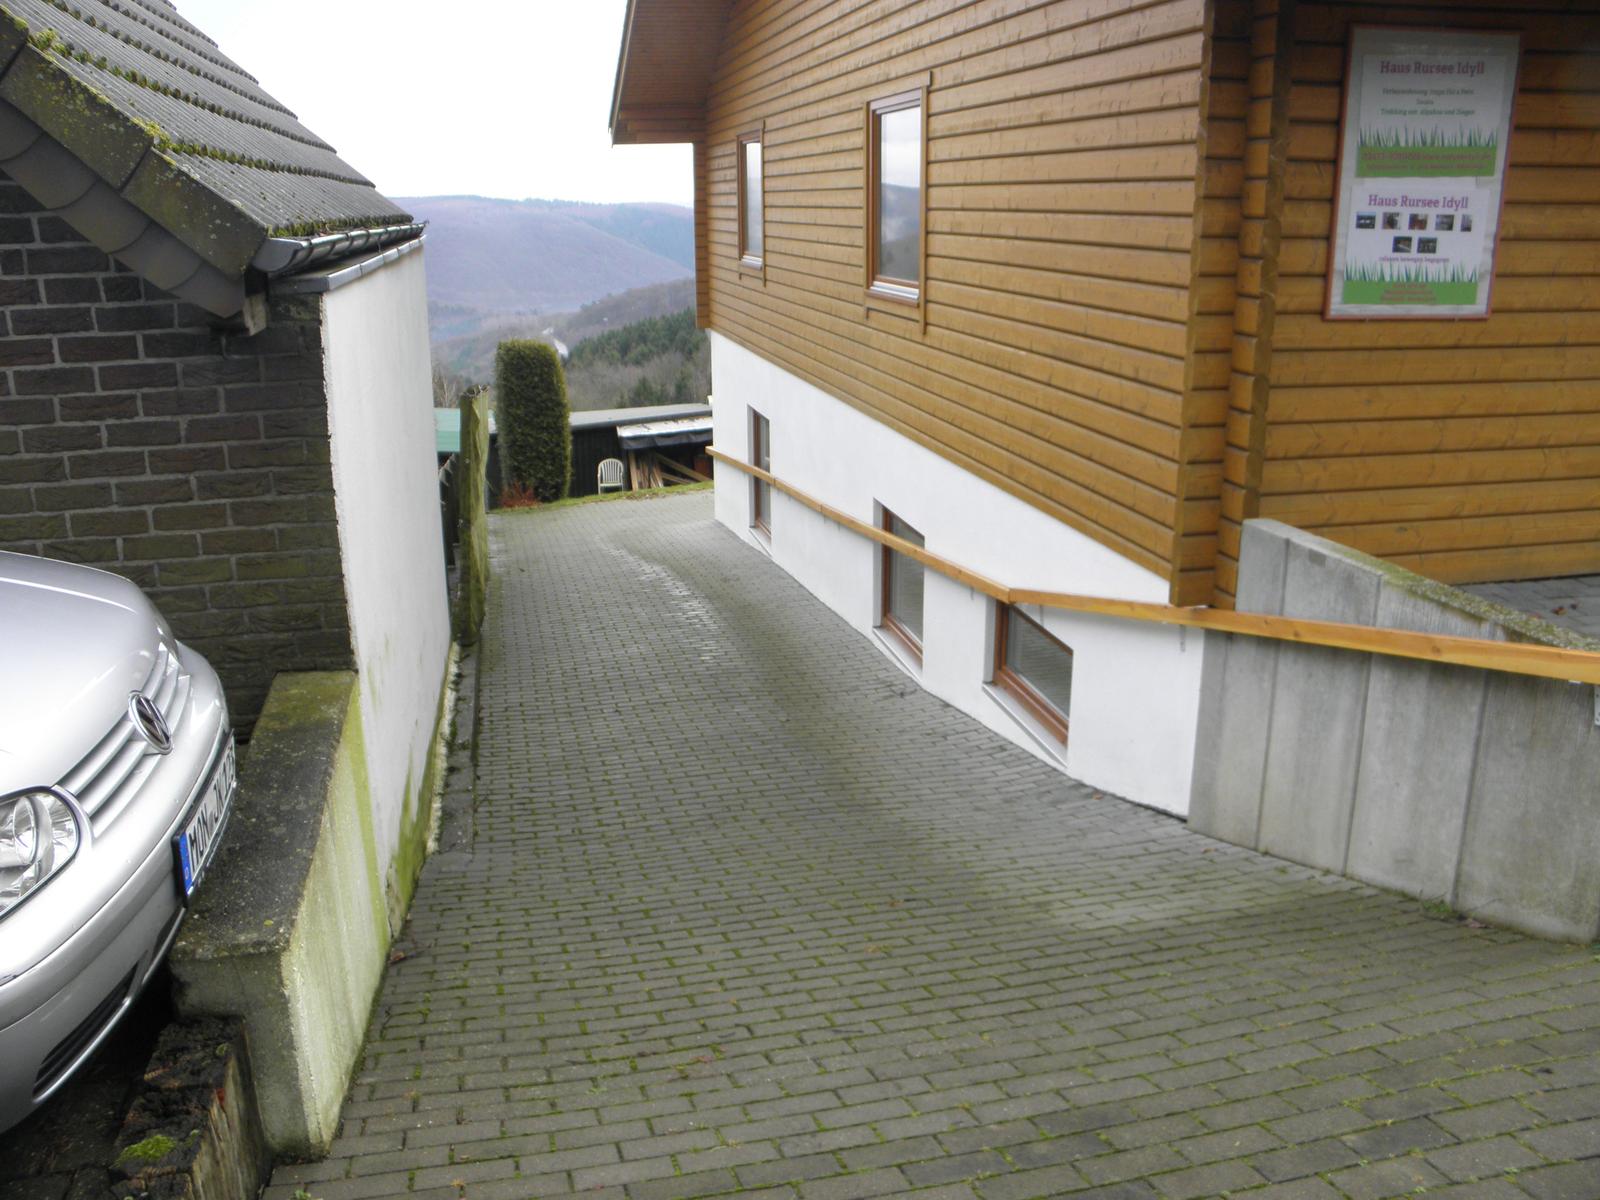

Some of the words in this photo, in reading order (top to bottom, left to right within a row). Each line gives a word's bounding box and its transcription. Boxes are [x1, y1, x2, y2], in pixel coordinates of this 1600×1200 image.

[1380, 61, 1410, 74] Haus
[1413, 61, 1454, 74] Rursee
[1456, 62, 1485, 77] Idyll
[1368, 194, 1397, 206] Haus
[1400, 195, 1439, 208] Rursee
[1441, 196, 1469, 211] Idyll
[189, 804, 209, 872] MON
